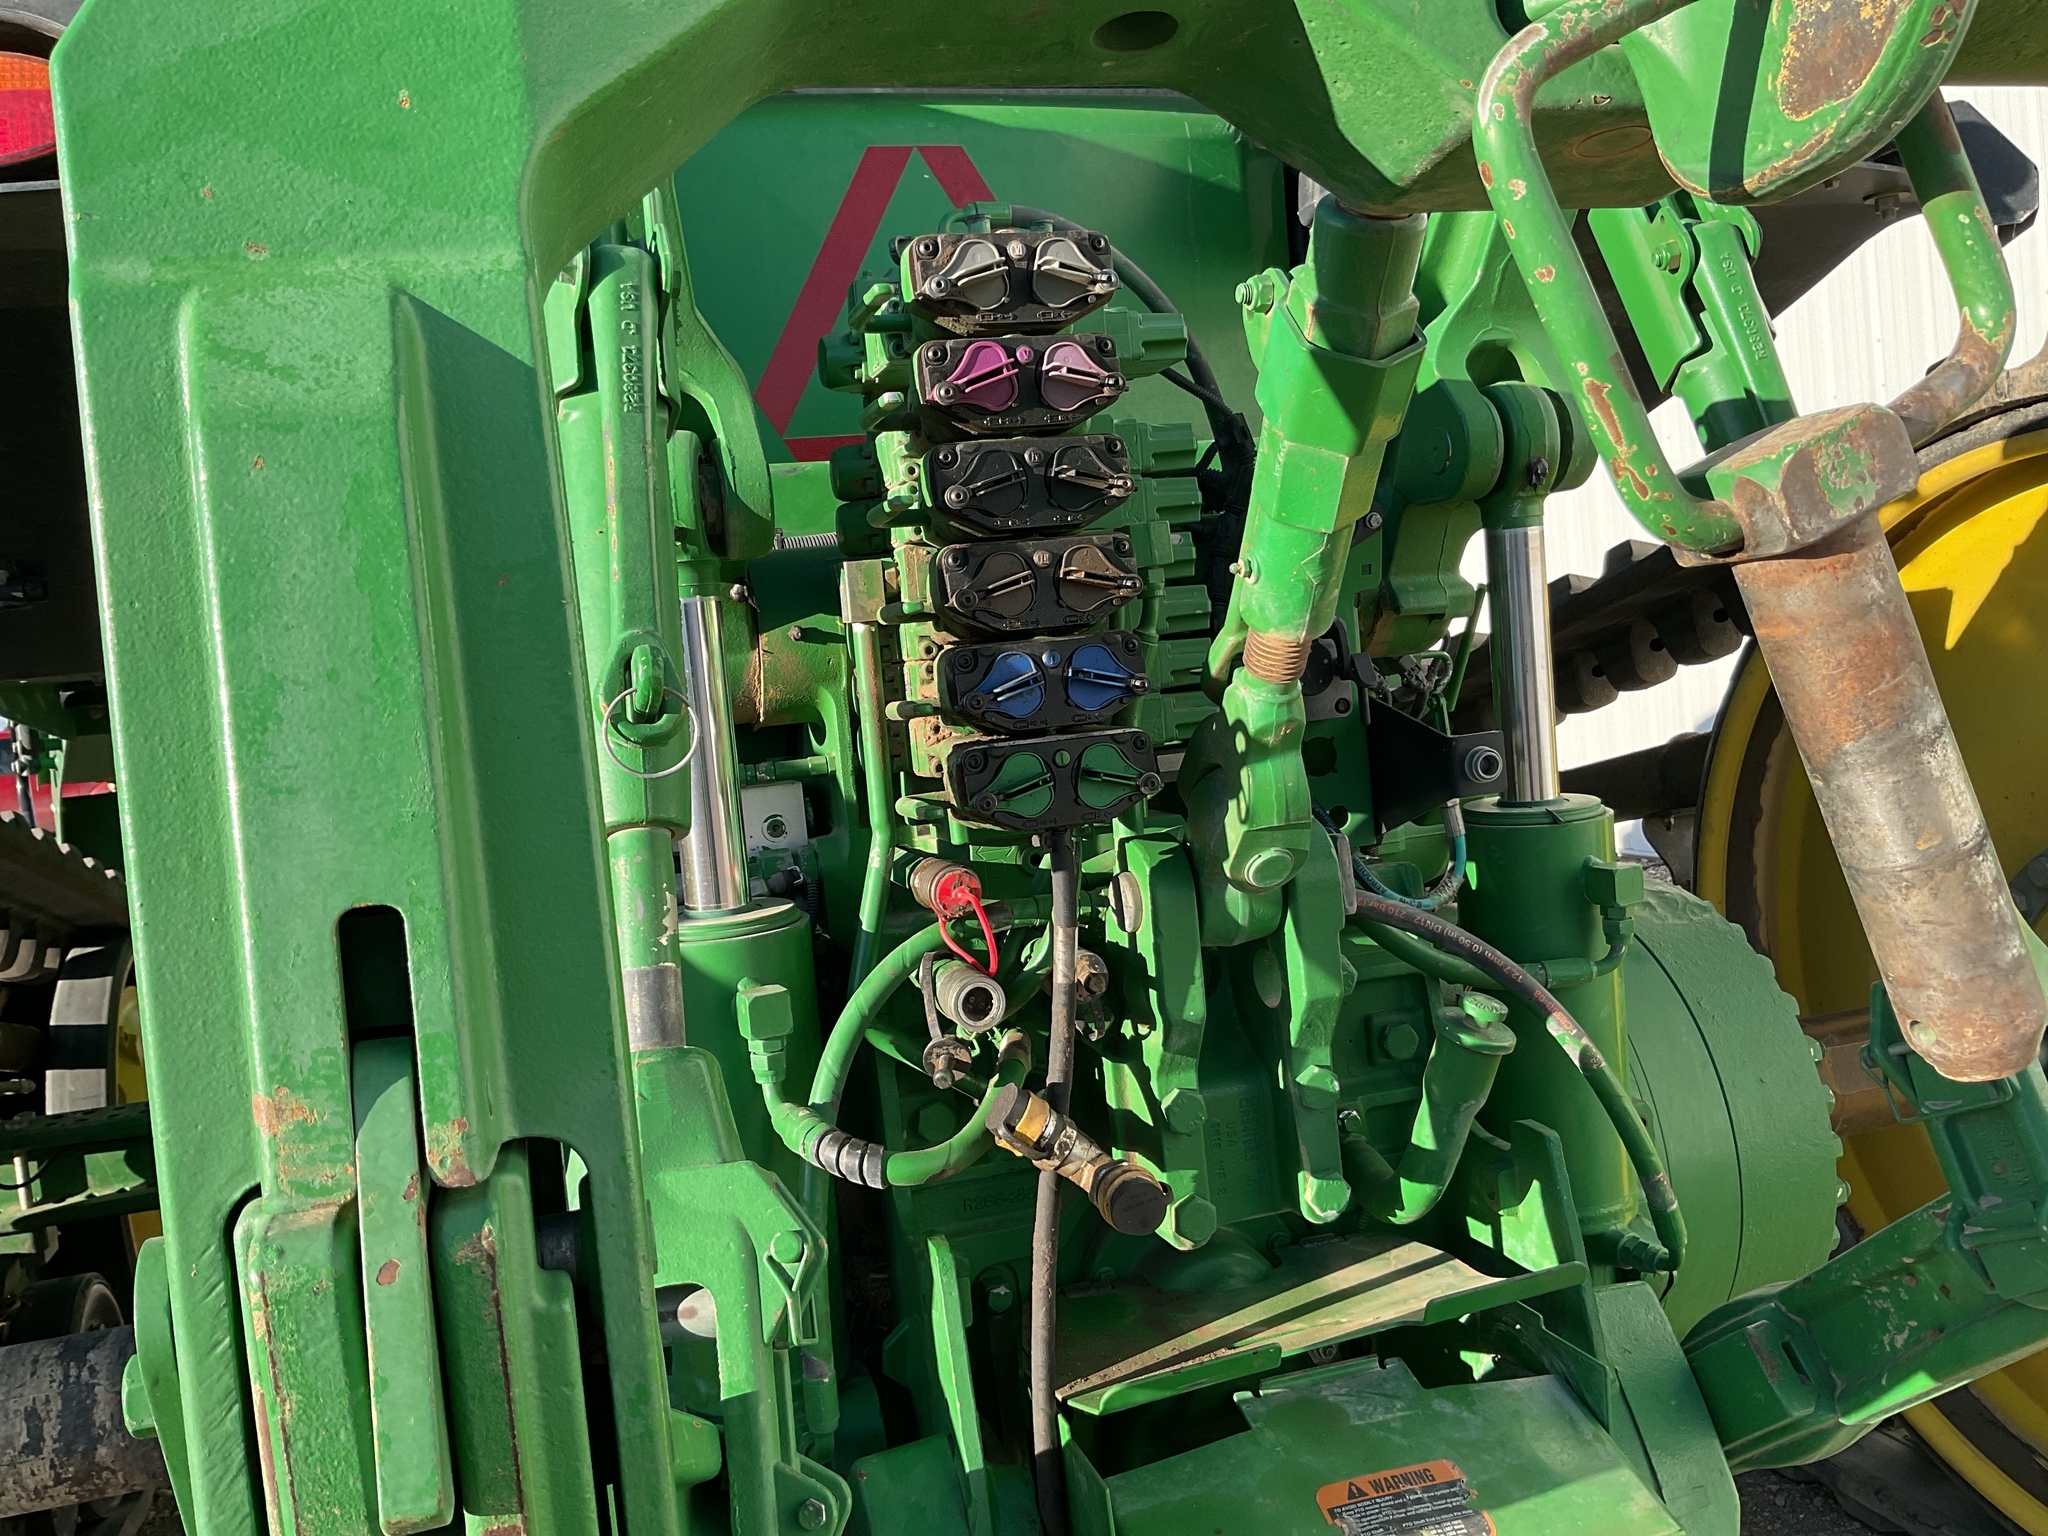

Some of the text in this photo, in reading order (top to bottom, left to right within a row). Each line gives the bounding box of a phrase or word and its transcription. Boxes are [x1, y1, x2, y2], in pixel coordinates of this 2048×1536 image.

[1720, 251, 1737, 277] USA
[1357, 897, 1367, 907] (3
[1369, 901, 1387, 912] bar
[1388, 906, 1407, 919] 210
[1413, 915, 1442, 934] DN12
[1443, 928, 1458, 939] in)
[1458, 936, 1483, 955] (0.50
[1484, 950, 1504, 967] mm
[1368, 1468, 1436, 1494] WARNING
